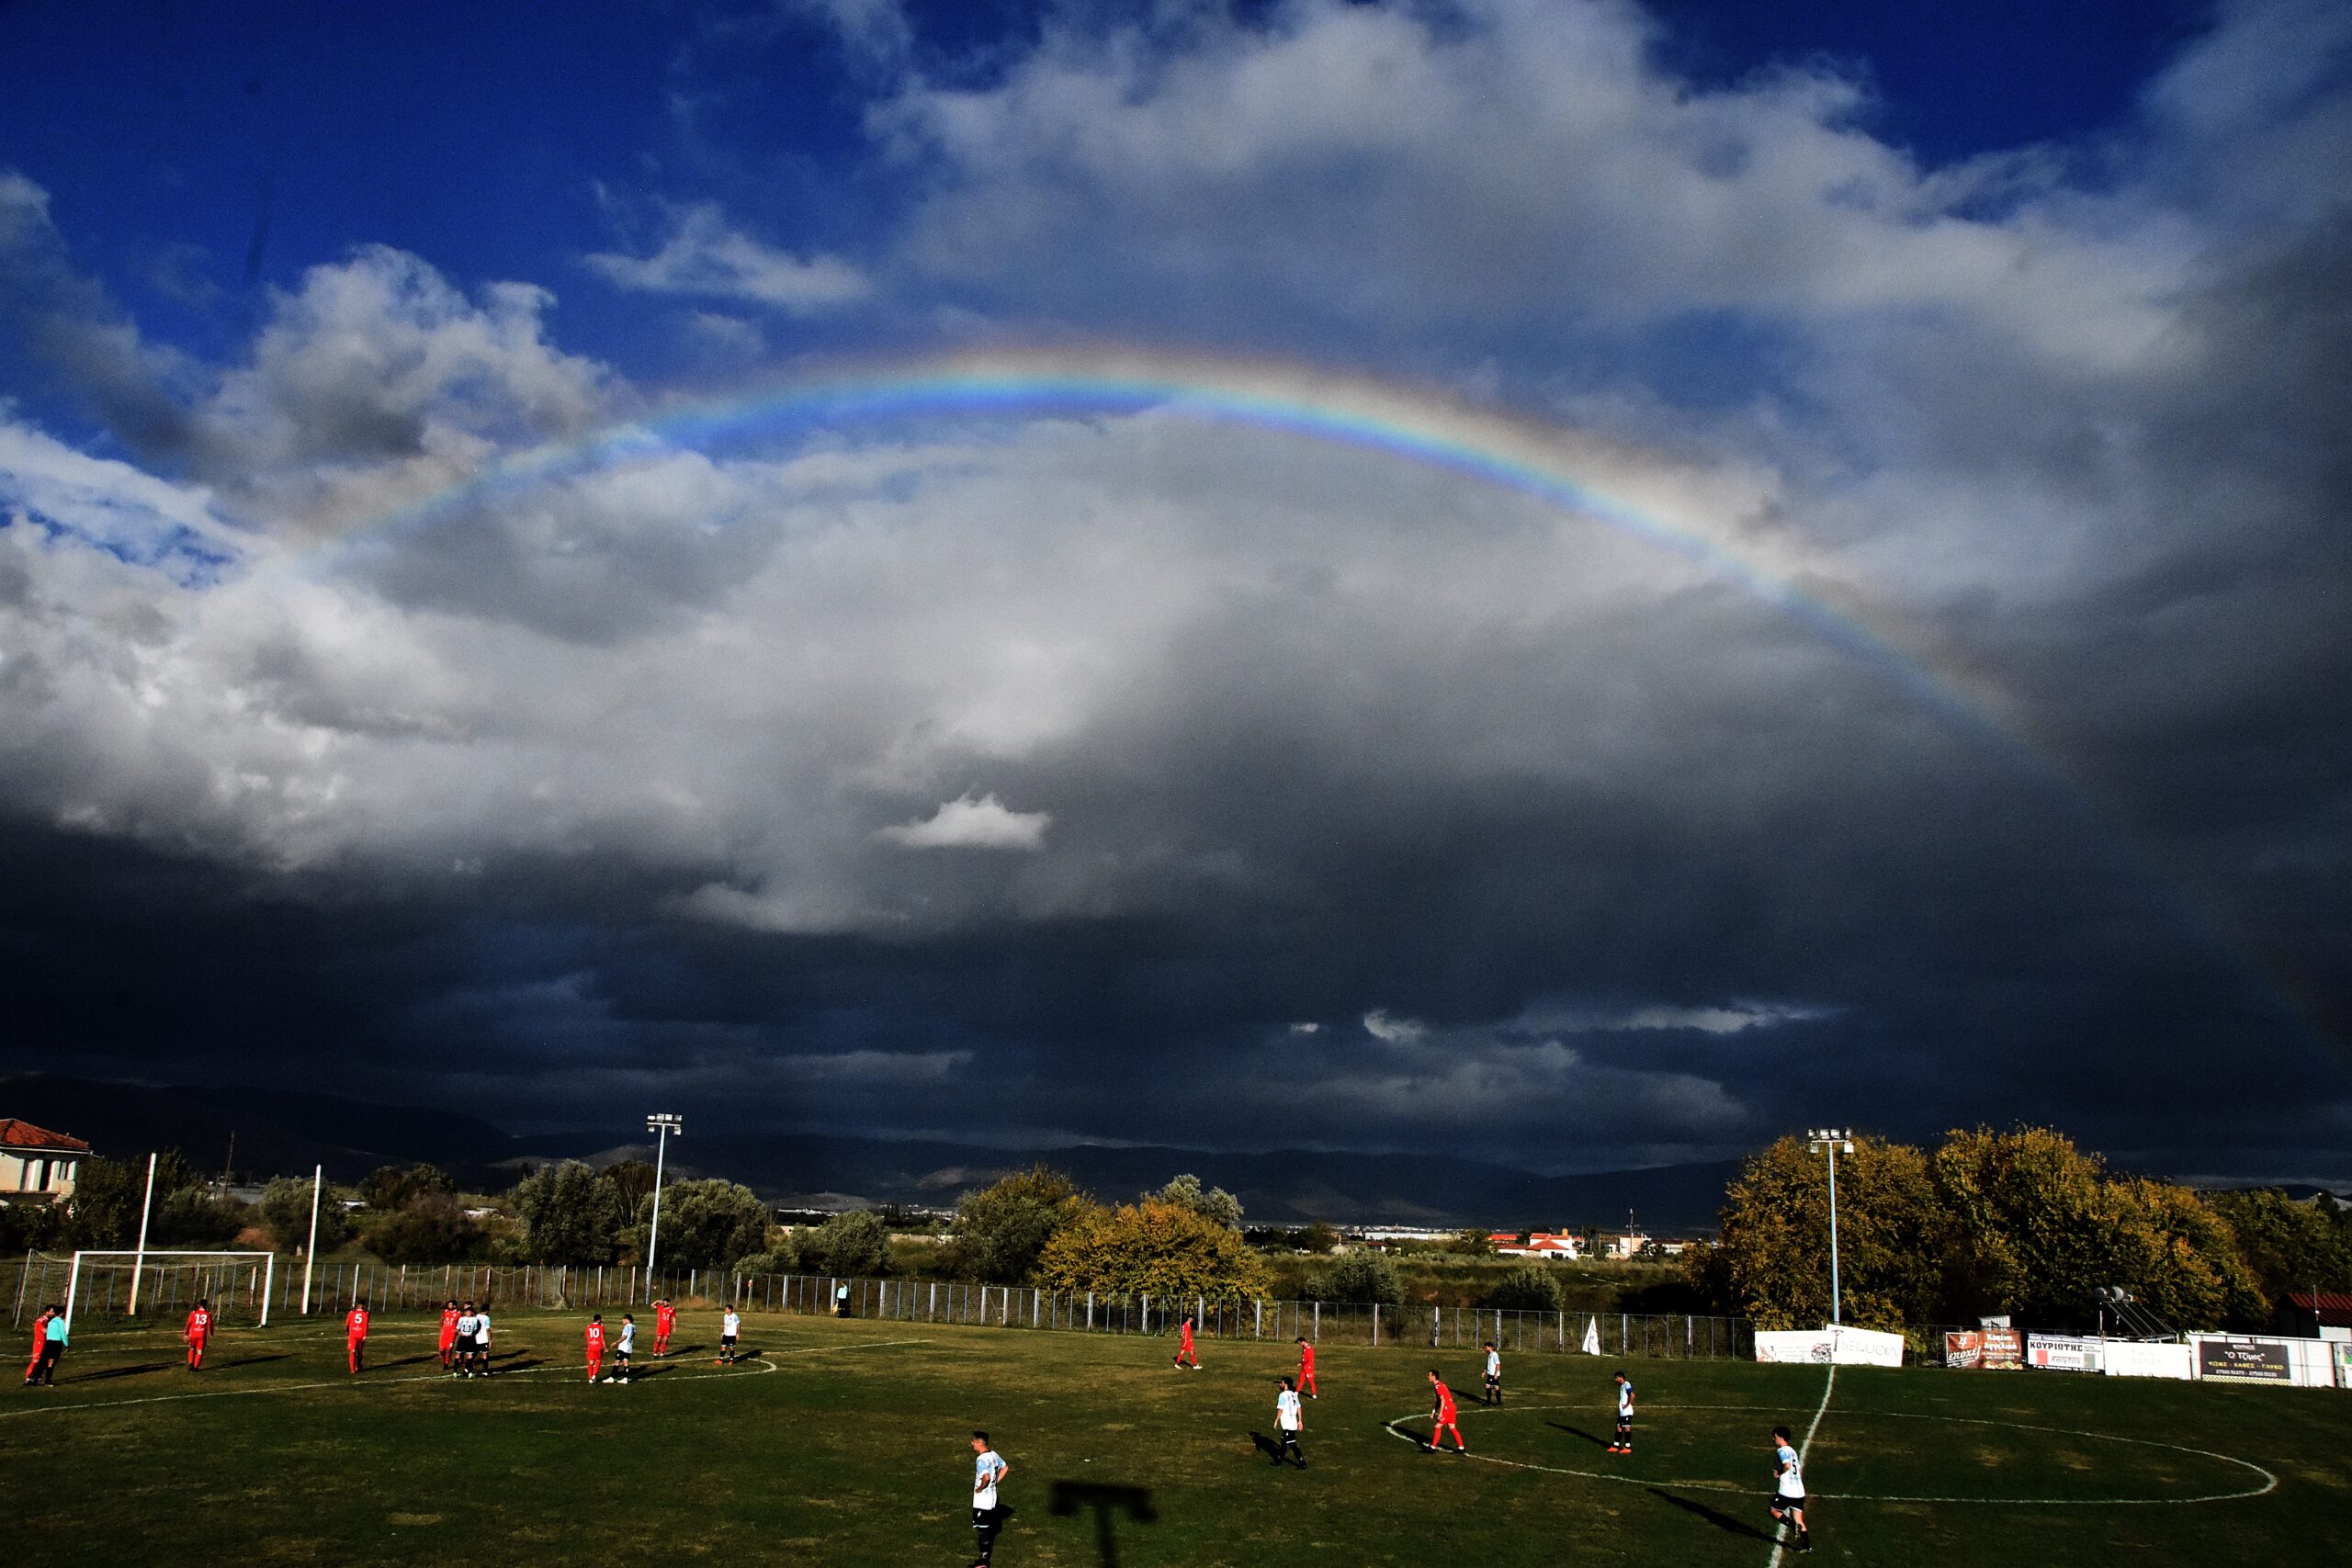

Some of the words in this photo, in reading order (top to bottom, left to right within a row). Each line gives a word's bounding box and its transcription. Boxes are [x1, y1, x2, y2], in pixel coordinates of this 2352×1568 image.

[195, 1314, 208, 1325] 13
[354, 1313, 363, 1324] 5
[588, 1327, 600, 1338] 10
[1958, 1336, 1967, 1348] 4
[2030, 1341, 2083, 1352] ΚΟΥΡΙΩΤΗΣ
[1840, 1338, 1897, 1358] SEQUOIA
[1792, 1459, 1798, 1474] 5
